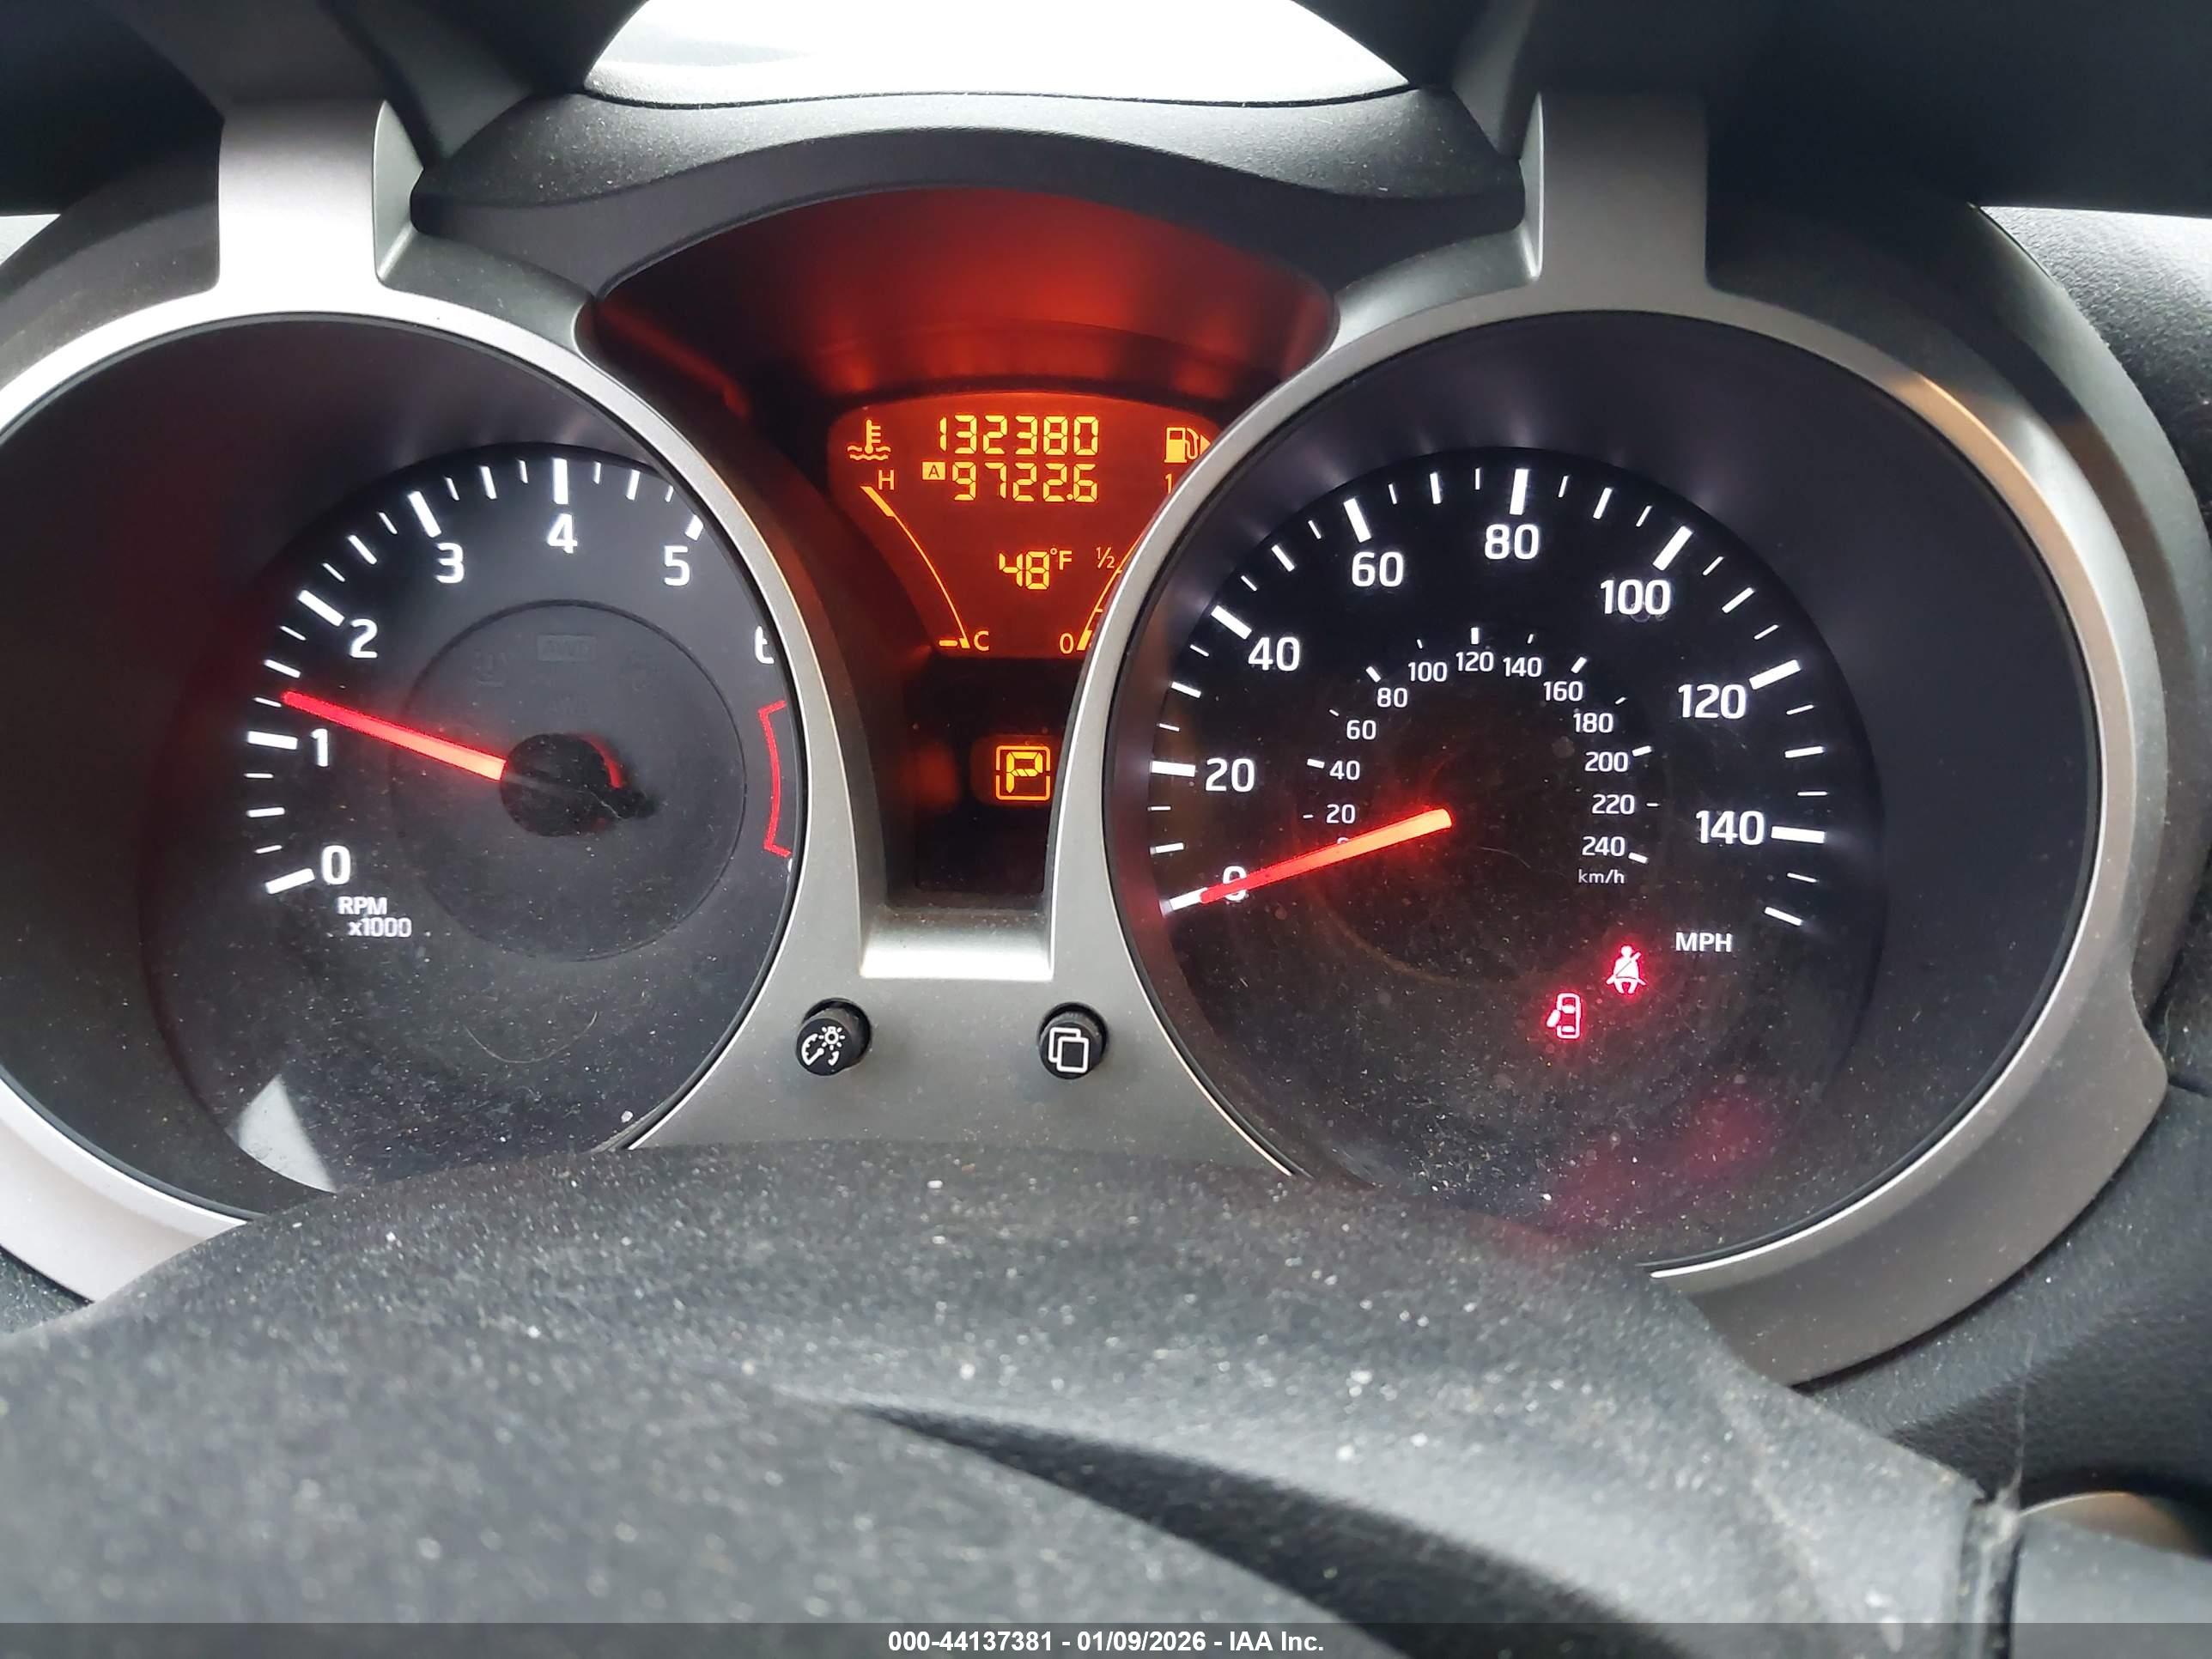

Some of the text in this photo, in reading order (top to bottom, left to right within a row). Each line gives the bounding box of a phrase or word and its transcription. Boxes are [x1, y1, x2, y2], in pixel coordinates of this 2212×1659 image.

[940, 415, 1098, 455] 132380
[878, 470, 895, 490] H
[952, 462, 1097, 502] 9722.6
[547, 514, 578, 554] 4
[1485, 524, 1539, 559] 80
[436, 543, 465, 583] 3
[664, 546, 691, 586] 5
[1352, 551, 1404, 586] 60
[1601, 580, 1671, 617] 100
[350, 619, 377, 658] 2
[974, 631, 988, 651] C
[1248, 637, 1300, 671] 40
[1456, 652, 1493, 672] 120
[1408, 662, 1447, 682] 100
[1504, 658, 1541, 677] 140
[1377, 688, 1407, 708] 80
[1544, 681, 1583, 701] 160
[1679, 684, 1747, 719] 120
[1347, 720, 1376, 739] 60
[1573, 713, 1613, 732] 180
[311, 729, 328, 767] 1
[1006, 752, 1043, 793] P
[1330, 761, 1359, 780] 40
[1585, 752, 1628, 772] 200
[1206, 757, 1255, 792] 20
[1327, 805, 1355, 823] 20
[1592, 794, 1635, 814] 220
[1696, 811, 1765, 845] 140
[1583, 836, 1625, 856] 240
[321, 845, 351, 885] 0
[1579, 869, 1624, 883] km/h
[337, 896, 387, 919] RPM
[348, 915, 411, 937] x1000
[1676, 933, 1733, 952] MPH
